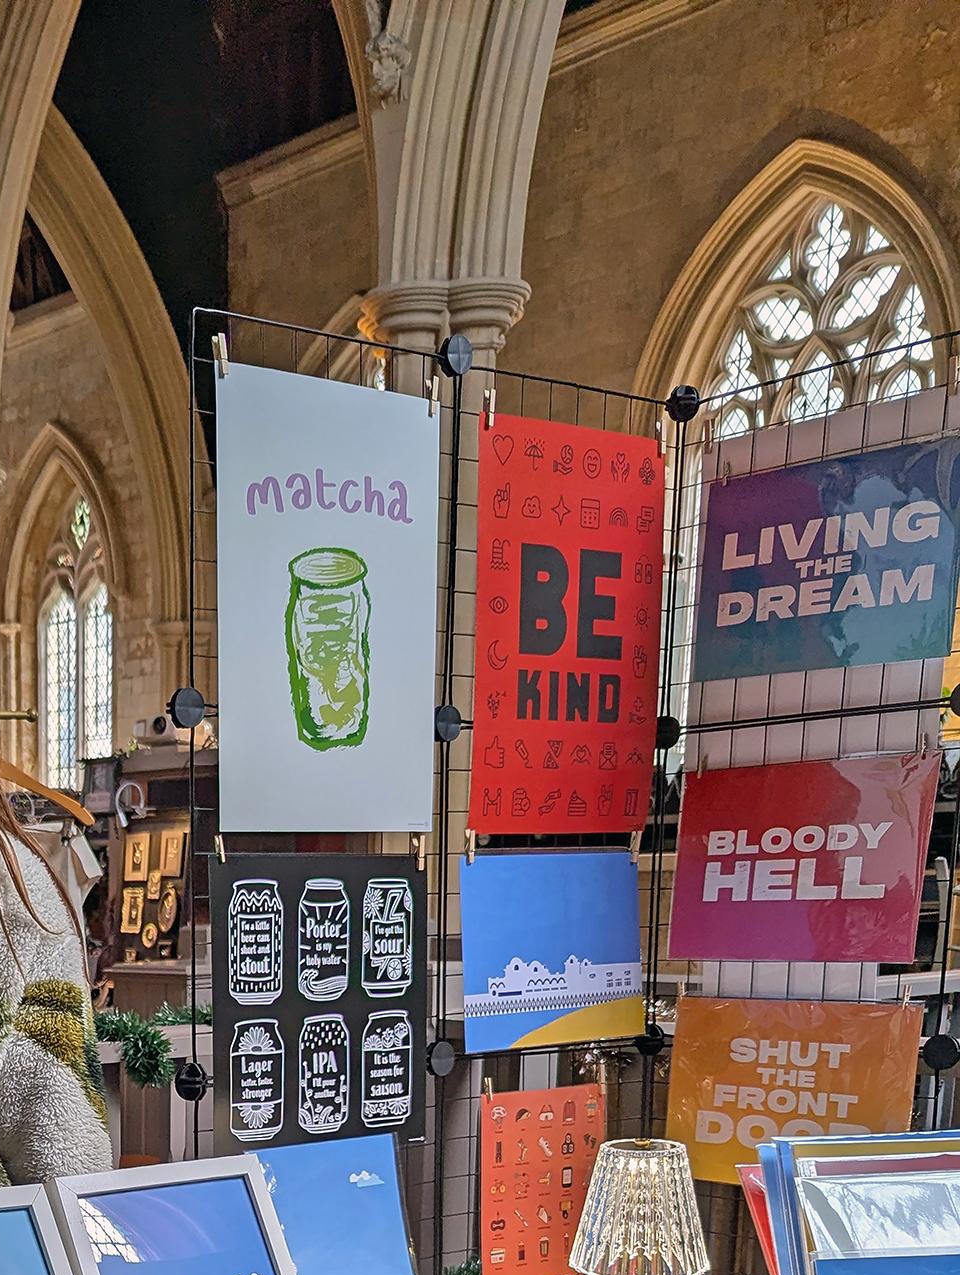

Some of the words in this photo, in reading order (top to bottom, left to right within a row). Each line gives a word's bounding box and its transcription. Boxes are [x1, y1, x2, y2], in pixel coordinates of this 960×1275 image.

[245, 468, 414, 525] matcha
[721, 500, 941, 571] LIVING
[795, 554, 852, 579] THE
[518, 543, 623, 661] BE
[716, 563, 936, 627] DREAM
[516, 669, 621, 724] KIND
[708, 822, 894, 856] BLOODY
[703, 857, 887, 902] HELL
[241, 932, 256, 943] beer
[305, 918, 342, 939] Porter
[240, 945, 256, 955] short
[257, 943, 271, 954] and
[315, 940, 322, 952] is
[322, 942, 333, 953] my
[374, 938, 403, 955] sour
[240, 956, 271, 975] stout
[306, 954, 320, 968] holy
[321, 954, 342, 966] water
[312, 1050, 338, 1075] IPA
[374, 1053, 382, 1065] It
[382, 1052, 388, 1063] is
[389, 1052, 401, 1063] the
[730, 1037, 851, 1069] SHUT
[241, 1056, 273, 1078] Lager
[370, 1068, 393, 1078] season
[393, 1064, 405, 1077] for
[757, 1067, 816, 1088] THE
[241, 1088, 272, 1101] stronger
[313, 1088, 336, 1099] another
[370, 1078, 404, 1097] saison
[713, 1084, 858, 1118] FRONT
